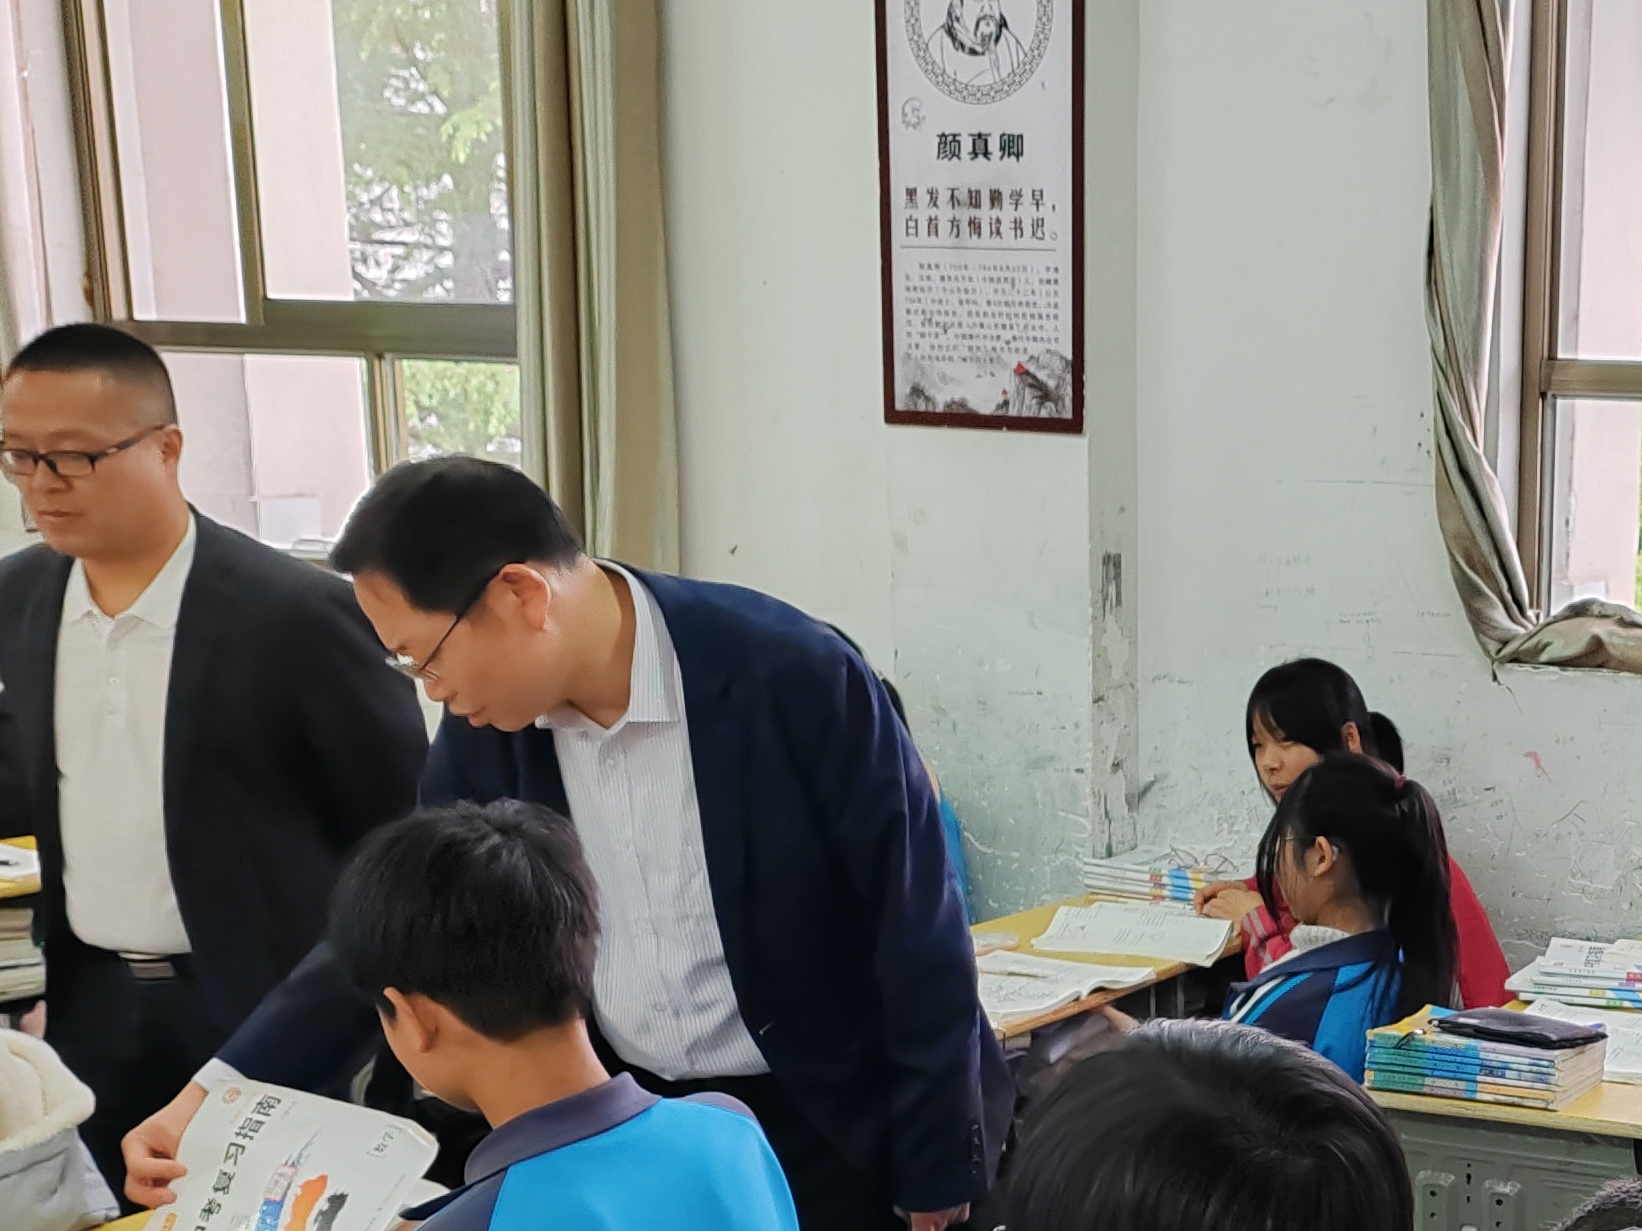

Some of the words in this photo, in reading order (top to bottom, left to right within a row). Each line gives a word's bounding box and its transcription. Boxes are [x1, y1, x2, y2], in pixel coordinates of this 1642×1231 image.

[936, 132, 1024, 163] 颜真卿
[904, 187, 1056, 212] 黑发不知勤学早,
[904, 215, 1058, 242] 白首方悔读书迟。
[372, 1128, 395, 1156] 数学
